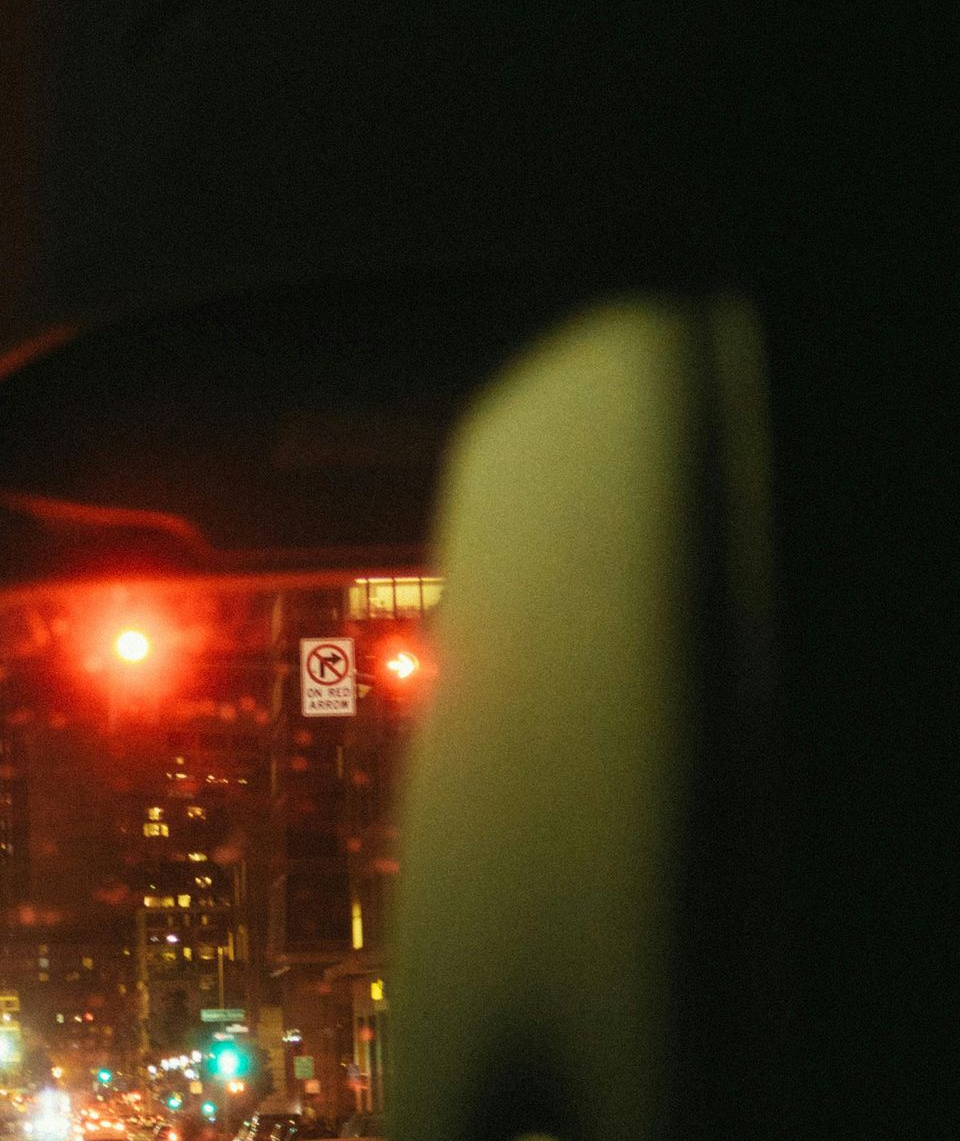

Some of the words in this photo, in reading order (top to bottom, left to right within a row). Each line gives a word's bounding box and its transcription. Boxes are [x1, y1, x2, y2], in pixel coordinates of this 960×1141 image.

[307, 687, 322, 698] ON
[328, 687, 351, 698] RED
[309, 700, 350, 710] ARROW
